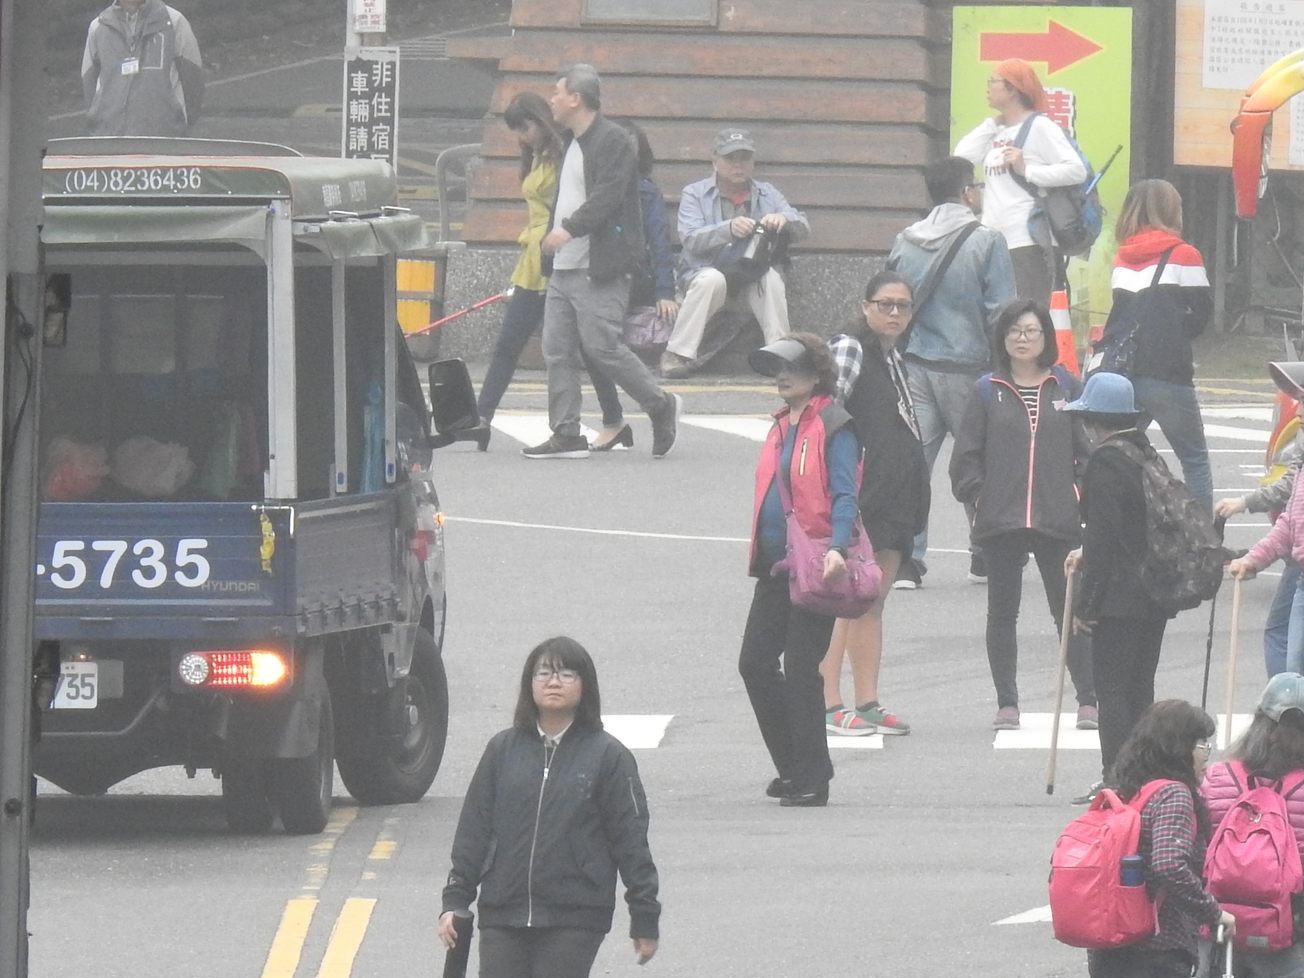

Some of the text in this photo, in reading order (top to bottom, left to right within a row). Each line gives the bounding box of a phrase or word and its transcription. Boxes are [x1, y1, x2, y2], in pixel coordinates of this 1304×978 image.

[349, 71, 369, 159] 車輛請
[66, 167, 201, 192] (04)8236436
